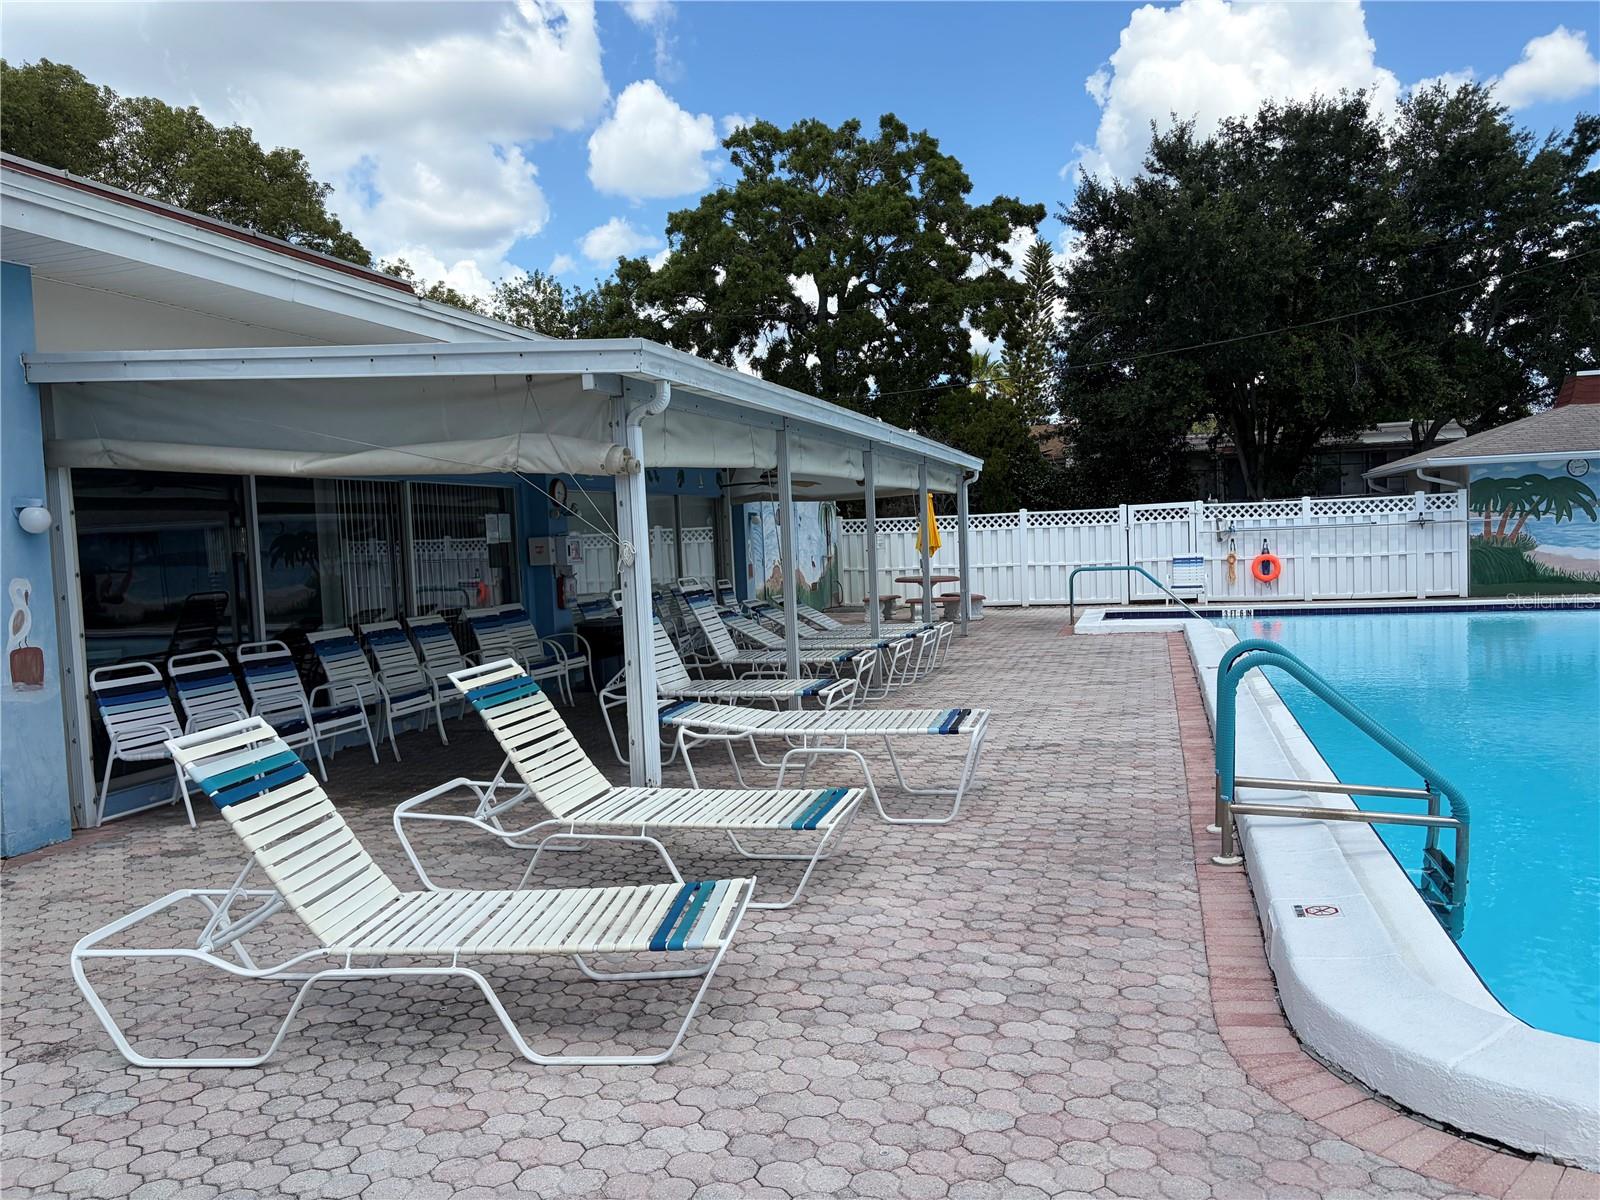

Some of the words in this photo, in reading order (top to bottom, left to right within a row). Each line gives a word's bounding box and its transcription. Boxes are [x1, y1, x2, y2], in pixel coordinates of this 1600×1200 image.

[1223, 609, 1228, 617] 3
[1239, 609, 1244, 617] 6
[1245, 609, 1253, 617] IN
